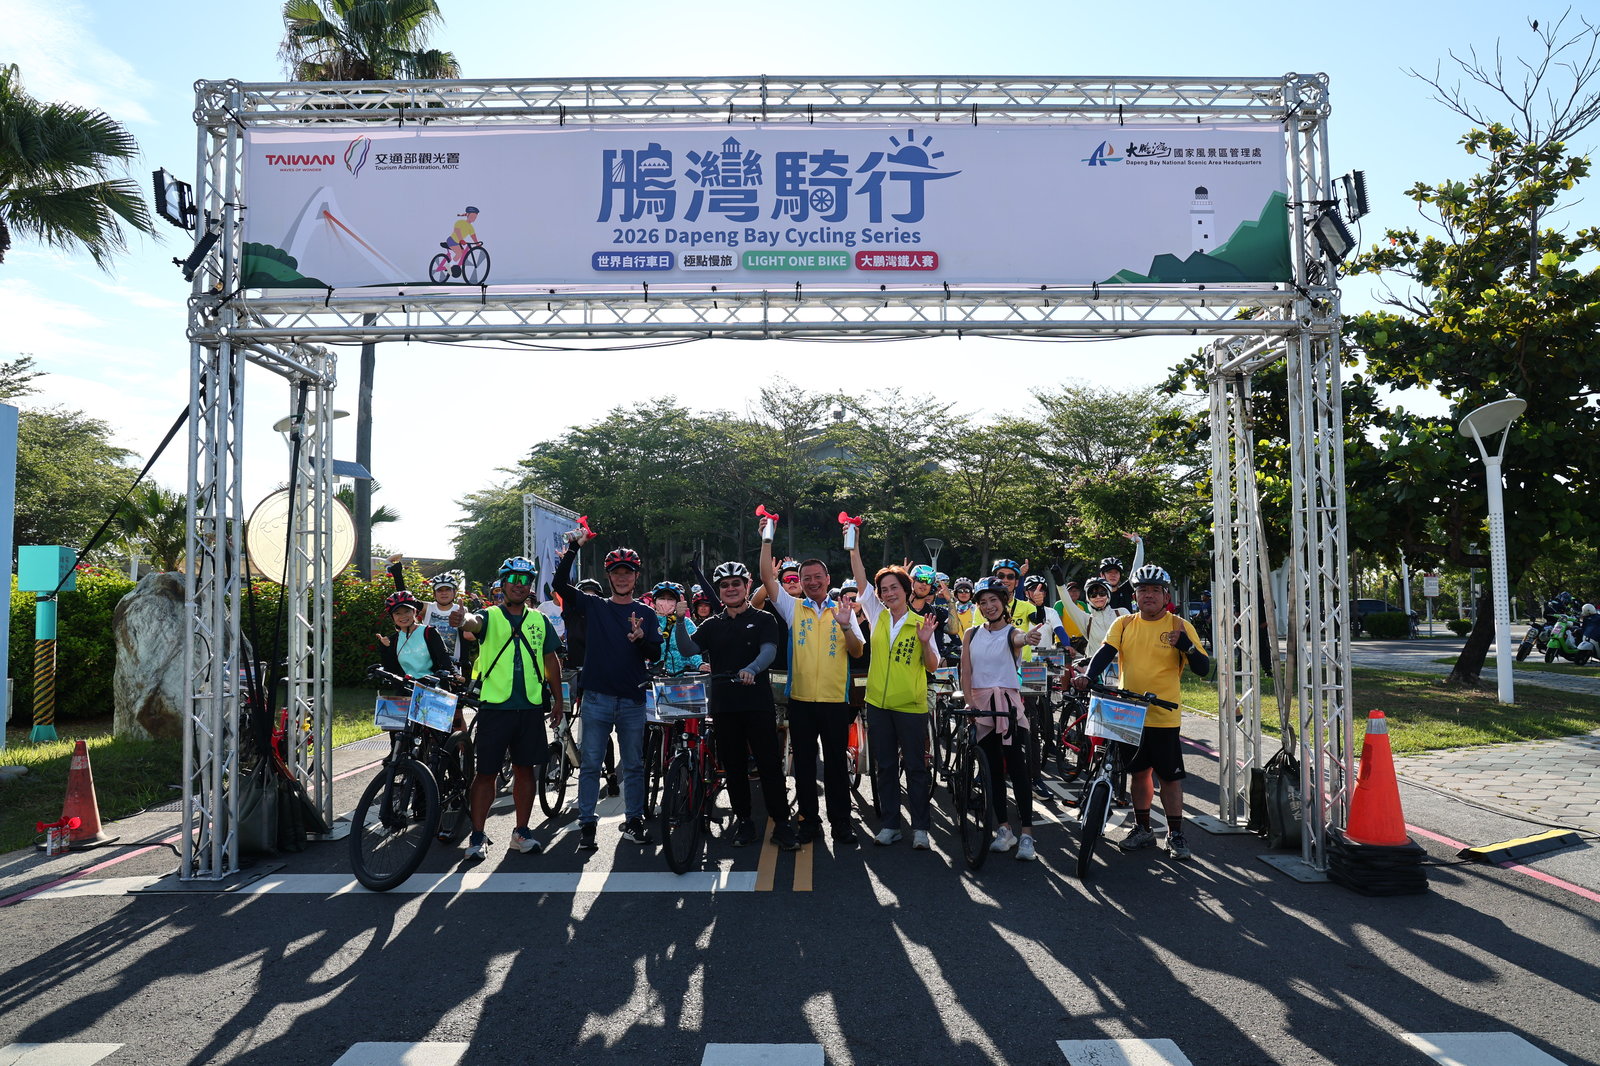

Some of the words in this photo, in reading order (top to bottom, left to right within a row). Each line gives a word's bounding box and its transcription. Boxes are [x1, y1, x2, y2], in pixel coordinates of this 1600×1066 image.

[265, 154, 335, 166] TAIWAN
[375, 153, 460, 164] 交通部觀光署
[597, 130, 962, 224] 鵬灣騎行
[612, 228, 660, 244] 2026
[665, 228, 739, 247] Dapeng
[744, 228, 780, 247] Bay
[785, 227, 857, 247] Cycling
[861, 227, 921, 243] Series
[597, 255, 670, 268] 世界自行車日
[683, 255, 732, 267] 極點慢旅
[748, 256, 786, 266] LIGHT
[788, 256, 815, 266] ONE
[818, 256, 847, 266] BIKE
[860, 255, 934, 268] 大鵬灣鐵人賽
